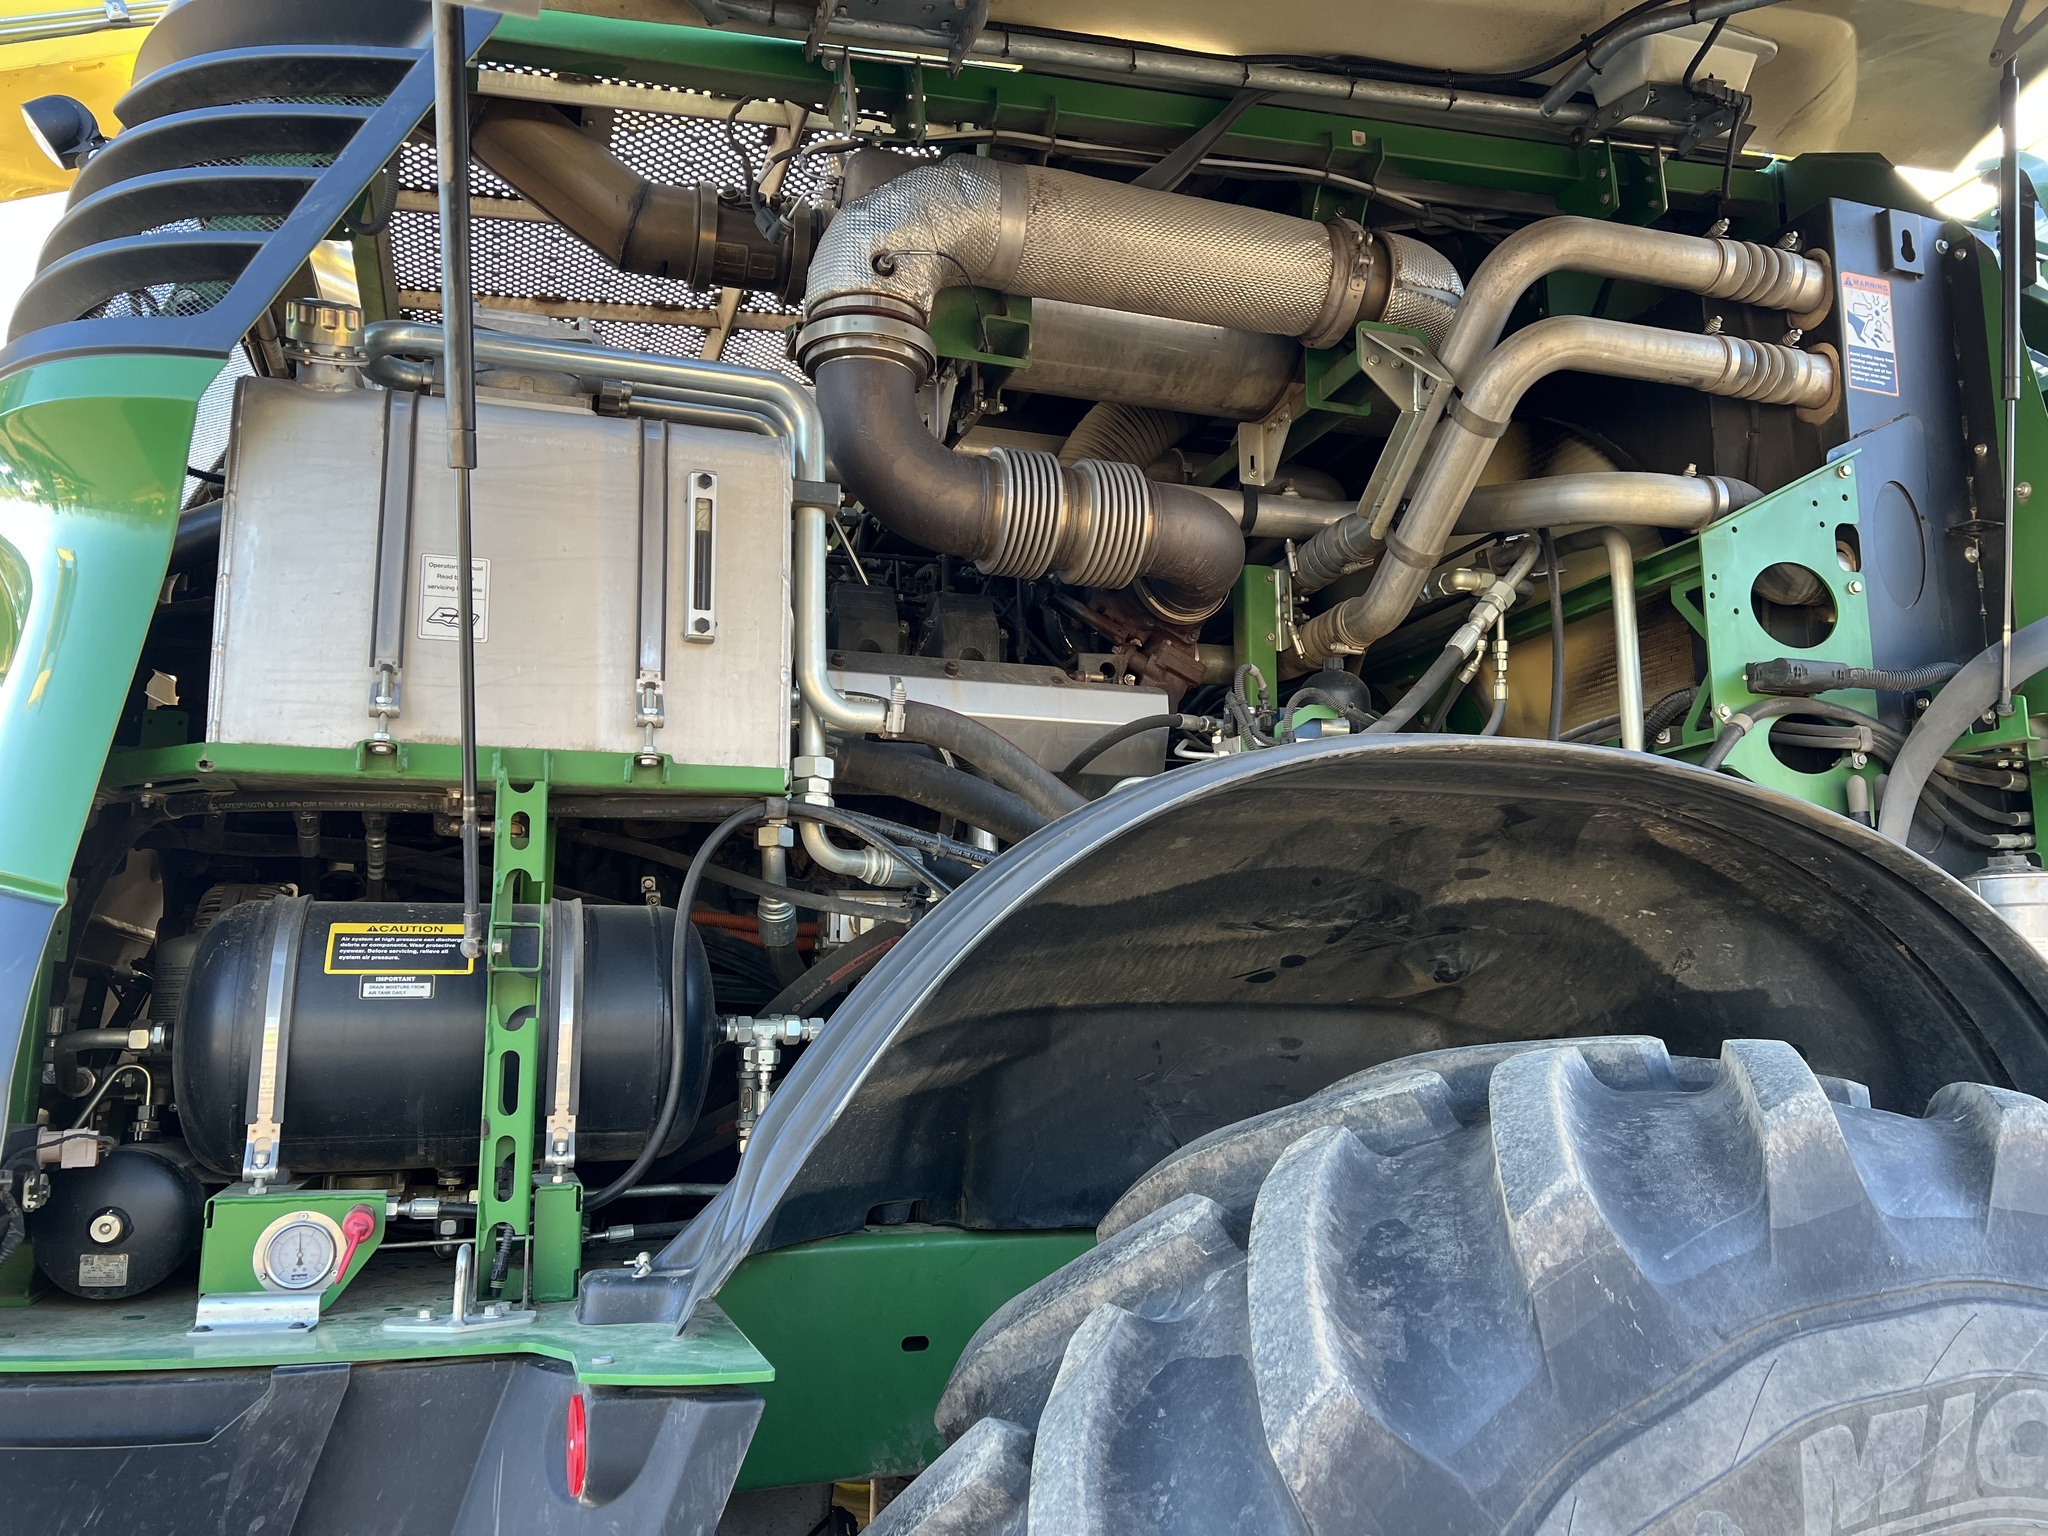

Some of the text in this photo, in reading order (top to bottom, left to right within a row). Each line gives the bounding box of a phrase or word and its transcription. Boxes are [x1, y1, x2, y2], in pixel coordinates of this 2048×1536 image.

[1853, 279, 1888, 291] WARNING
[427, 584, 456, 592] servicing
[379, 925, 444, 933] CAUTION
